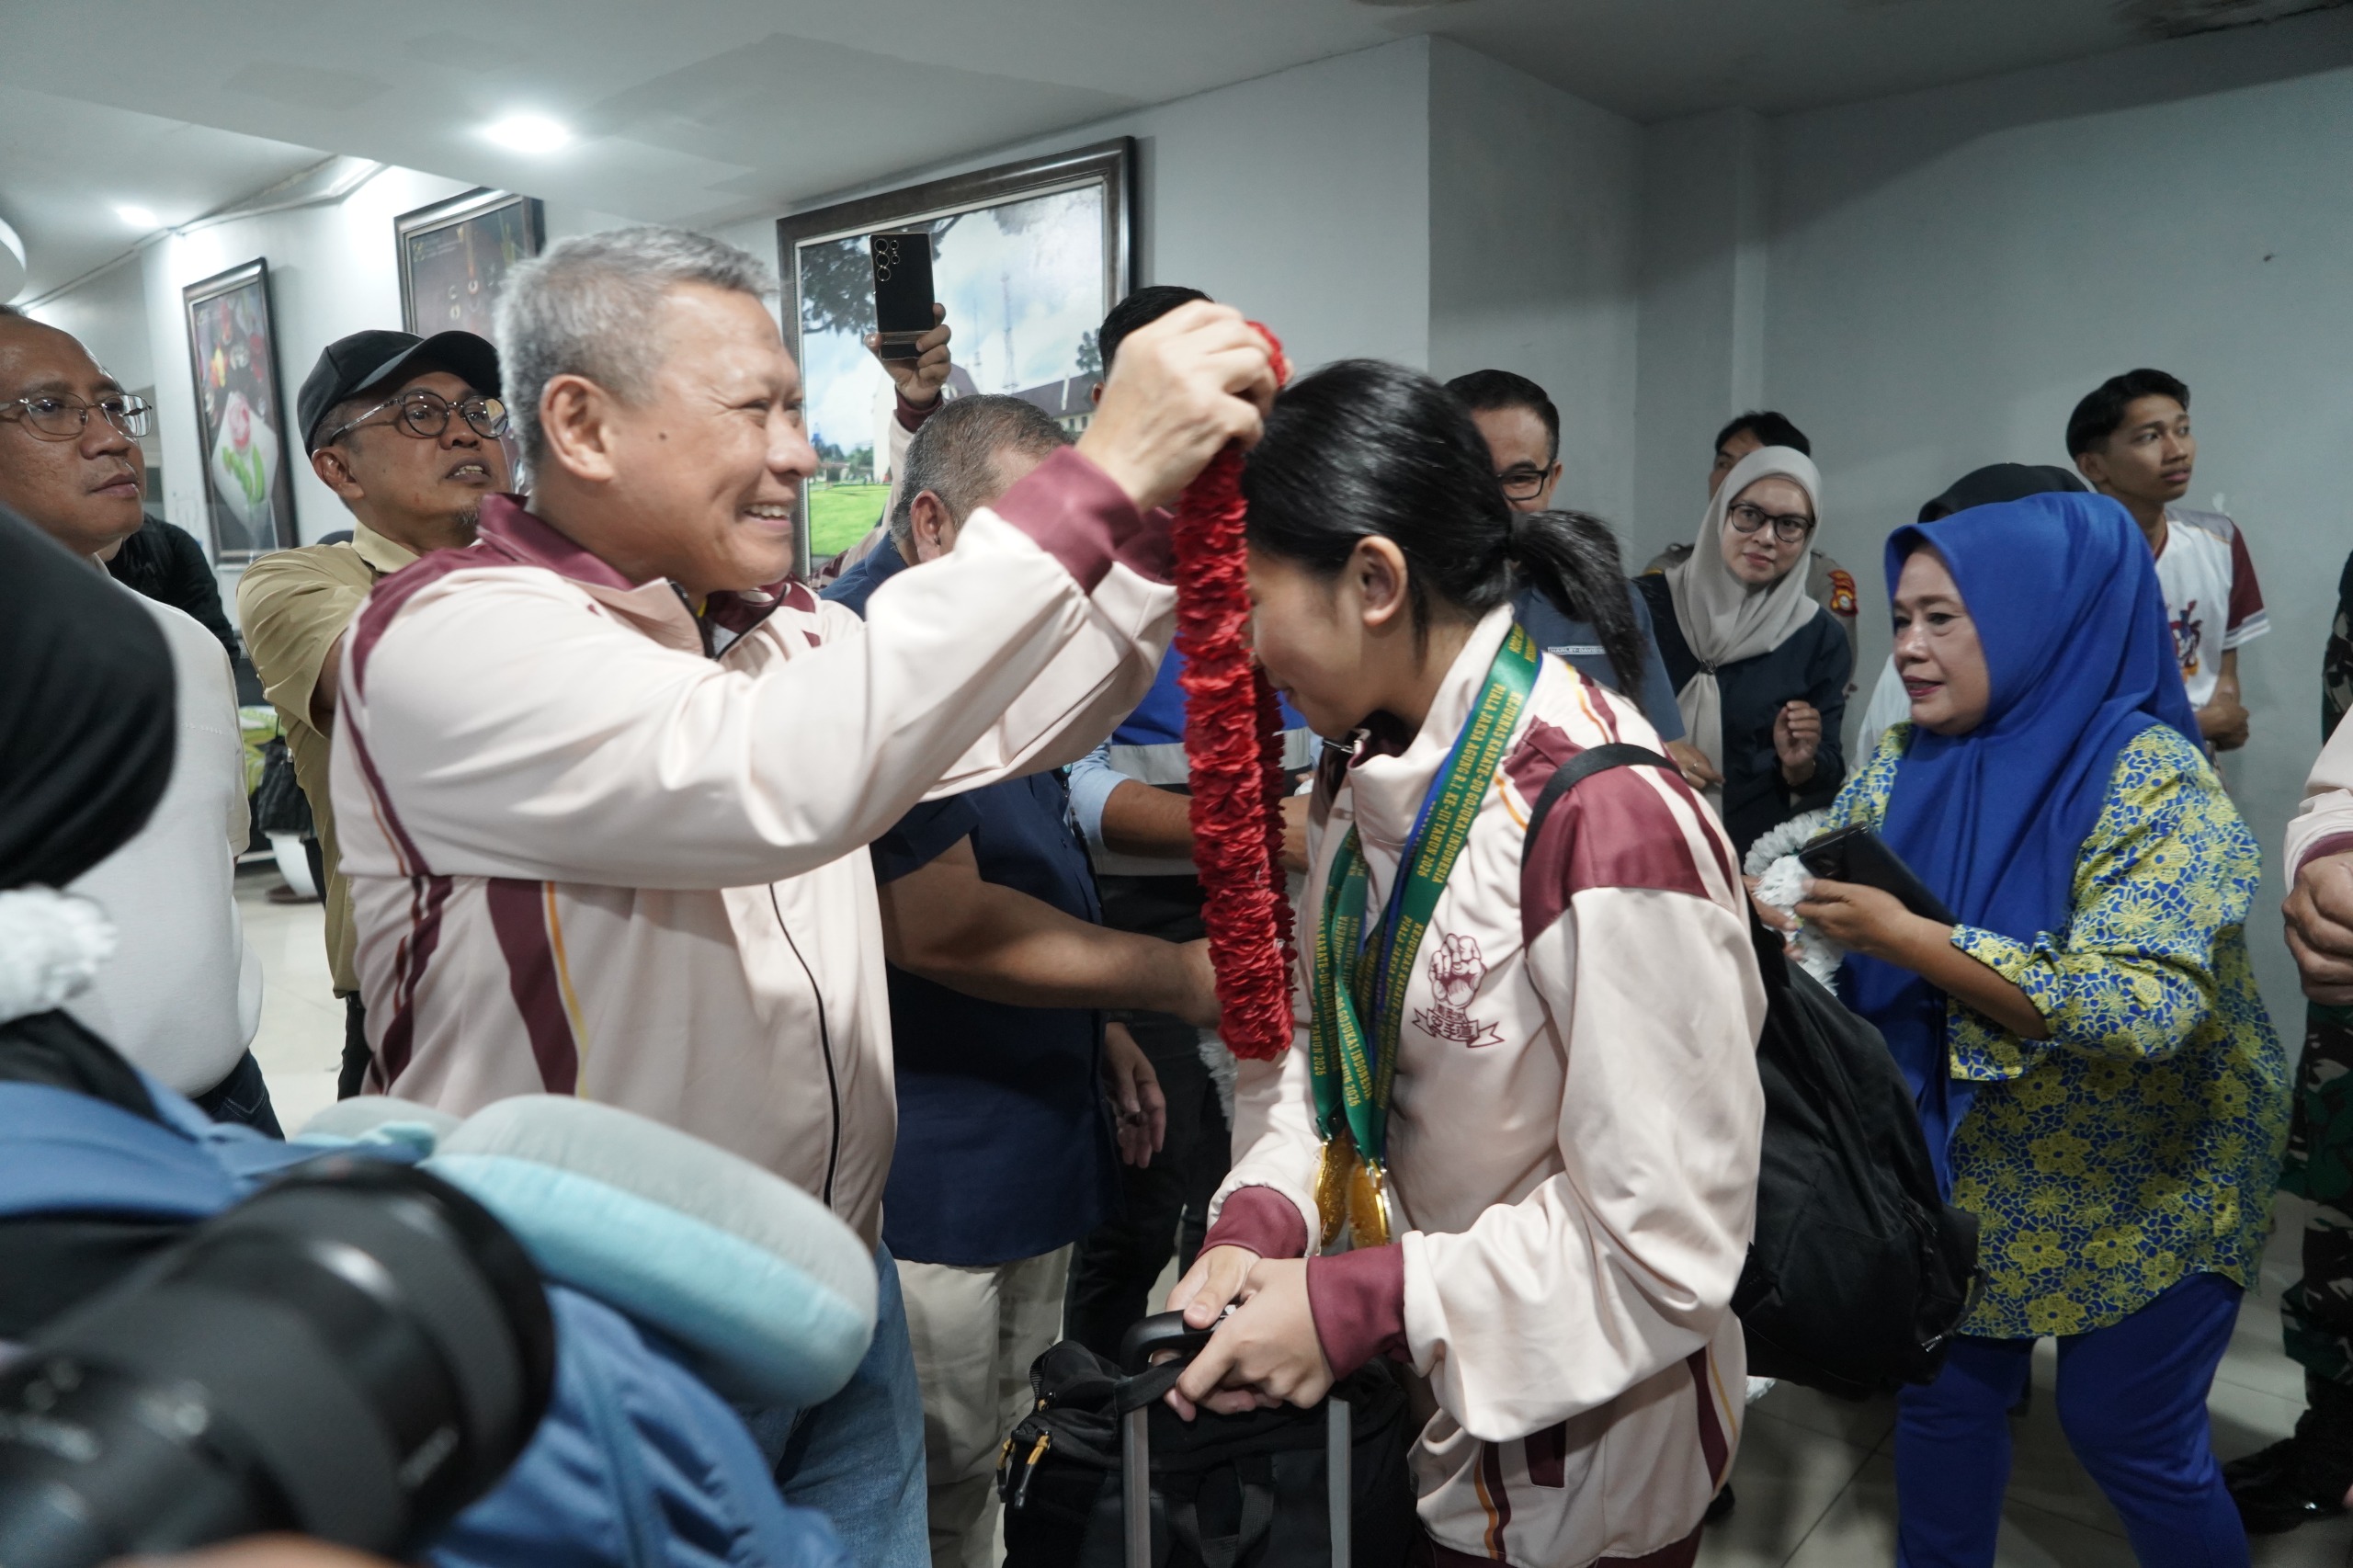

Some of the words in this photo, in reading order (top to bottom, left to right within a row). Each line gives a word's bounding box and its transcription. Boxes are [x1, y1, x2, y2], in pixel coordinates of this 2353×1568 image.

[1483, 683, 1506, 710] PIALA
[1469, 710, 1494, 741] JAKSA
[1493, 690, 1524, 739] KEJURNAS
[1456, 742, 1479, 774] AGUNG
[1470, 737, 1503, 792] KARATE-DO
[1453, 791, 1479, 833] GOJUKAI
[1426, 823, 1447, 855] TAHUN
[1416, 854, 1434, 878] 2026
[1431, 833, 1461, 883] INDONESIA
[1401, 922, 1425, 972] KEJURNAS
[1313, 1054, 1327, 1076] 2026
[1336, 1007, 1356, 1051] GOJUKAI
[1350, 1048, 1373, 1101] INDONESIA
[1345, 1084, 1362, 1108] 2026
